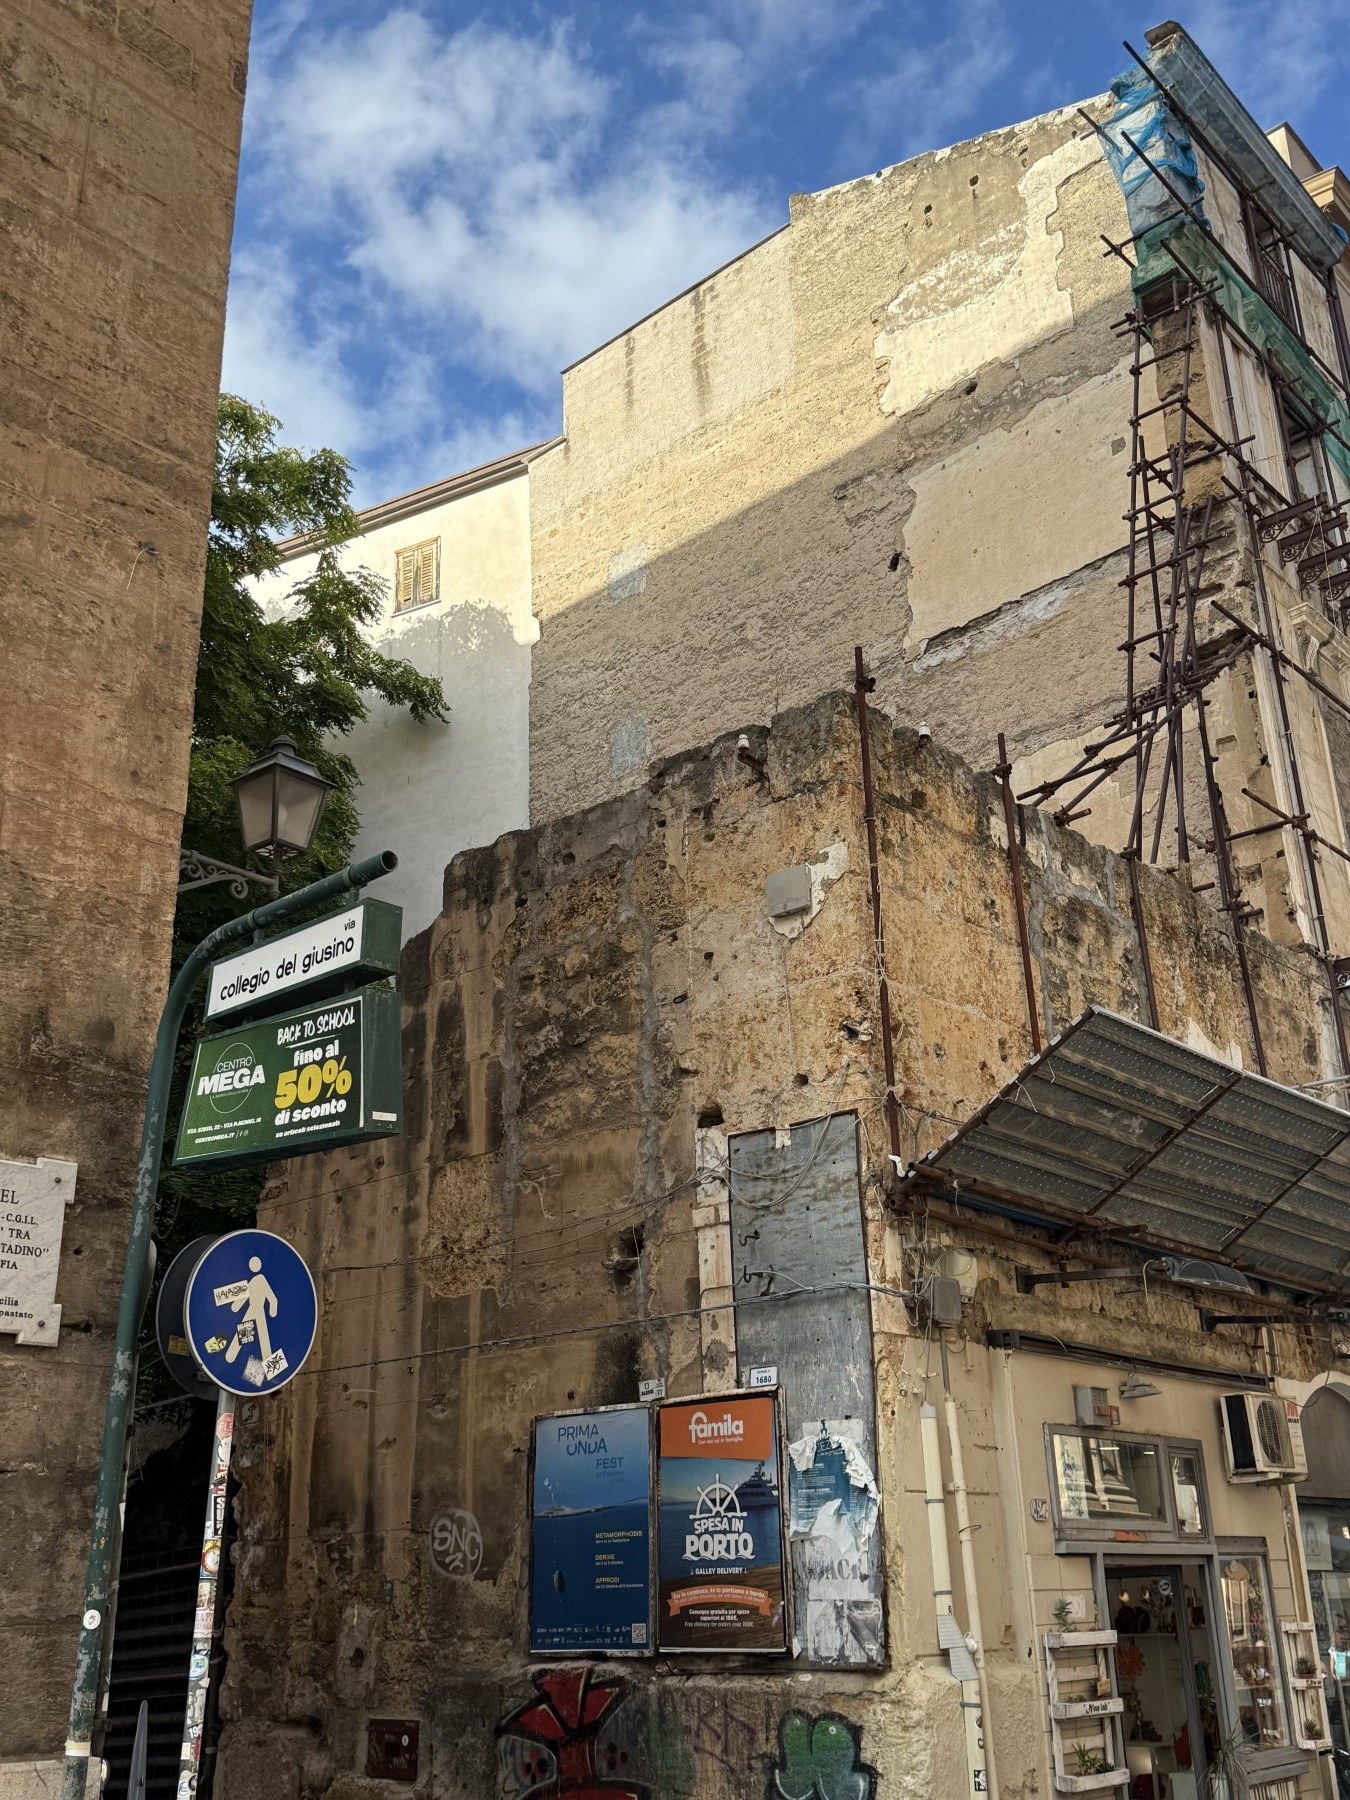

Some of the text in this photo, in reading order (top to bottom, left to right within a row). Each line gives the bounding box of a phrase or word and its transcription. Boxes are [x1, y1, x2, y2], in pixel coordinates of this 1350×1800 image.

[344, 919, 356, 931] via
[220, 937, 355, 1001] collegio del giusino
[277, 1005, 356, 1046] BACK TO SCHOOL
[293, 1039, 340, 1067] fino al
[216, 1056, 253, 1073] CENTRO
[197, 1064, 266, 1096] MEGA
[274, 1055, 353, 1109] 50%
[274, 1108, 291, 1126] di
[292, 1098, 347, 1122] sconto
[306, 1119, 341, 1133] selezionati
[8, 1228, 31, 1240] TRA
[0, 1259, 18, 1270] FIA
[755, 1375, 772, 1385] 1680
[557, 1423, 599, 1442] PRIMA
[688, 1411, 744, 1444] famila
[596, 1456, 625, 1469] FEST
[693, 1517, 744, 1534] SPESA IN
[595, 1530, 643, 1539] METAMORPHOSIS
[681, 1532, 756, 1561] PORTO
[595, 1553, 615, 1561] DERIVE
[695, 1567, 743, 1575] GALLEY DELIVERY
[595, 1576, 620, 1584] APPRODI
